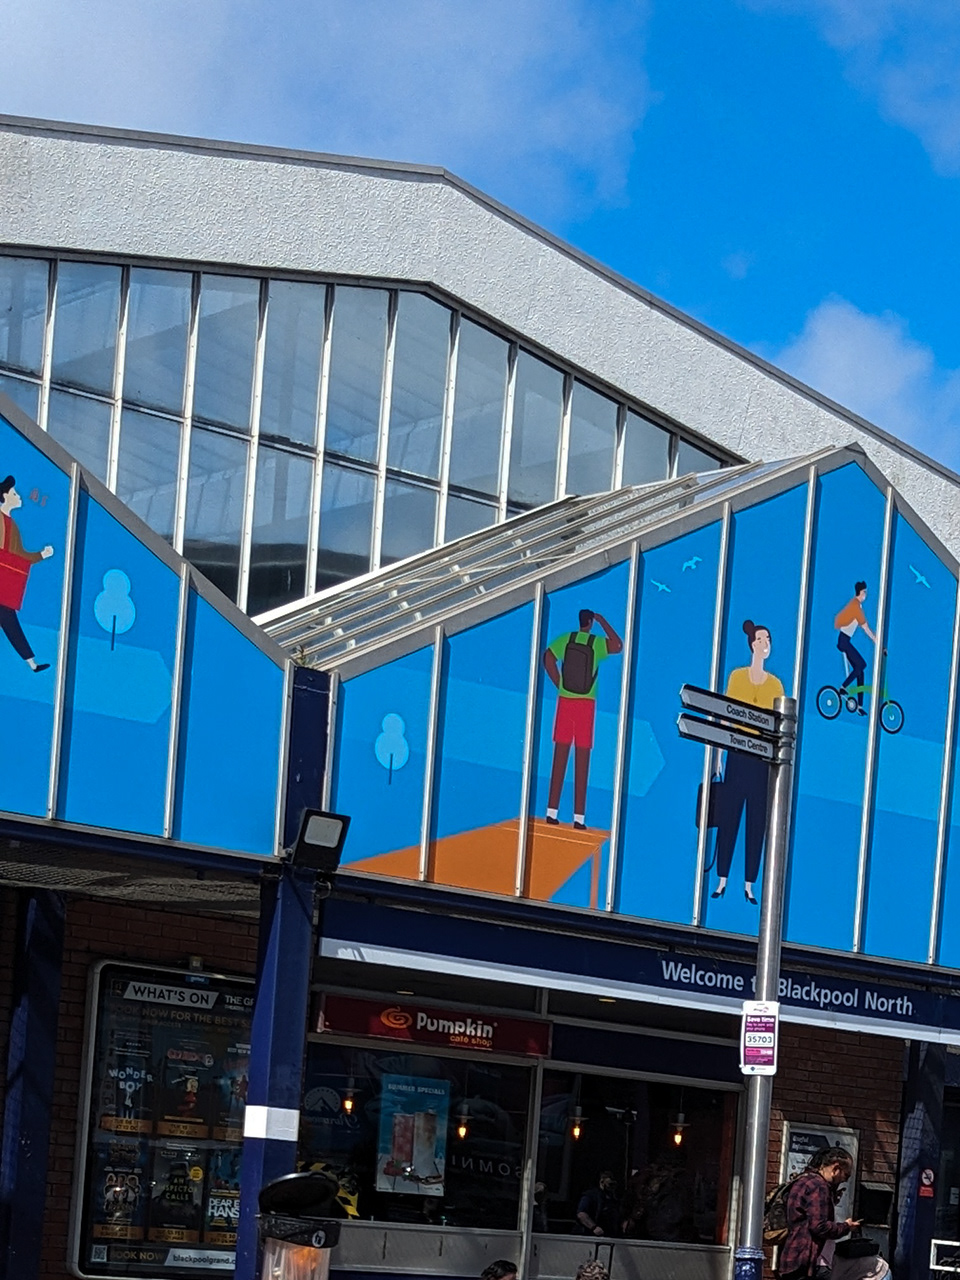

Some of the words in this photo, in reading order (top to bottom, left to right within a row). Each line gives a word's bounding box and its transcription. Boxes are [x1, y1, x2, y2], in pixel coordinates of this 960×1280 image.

[726, 704, 747, 719] Coach
[748, 711, 770, 726] Station
[729, 734, 747, 748] Town
[747, 739, 768, 754] Centre
[661, 959, 745, 992] Welcome
[777, 977, 859, 1009] Blackpool
[864, 991, 914, 1017] North
[132, 984, 186, 1003] WHAT'S
[189, 992, 210, 1006] ON
[225, 994, 242, 1006] THE
[171, 1010, 191, 1021] FOR
[193, 1012, 212, 1024] THE
[416, 1011, 494, 1039] Pumpkin
[471, 1036, 492, 1047] shop
[747, 1035, 772, 1044] 35703
[108, 1066, 154, 1083] WONDER
[119, 1080, 143, 1092] BOY
[165, 1193, 190, 1201] CALLS
[208, 1197, 233, 1208] DEAR
[208, 1206, 240, 1219] HANS
